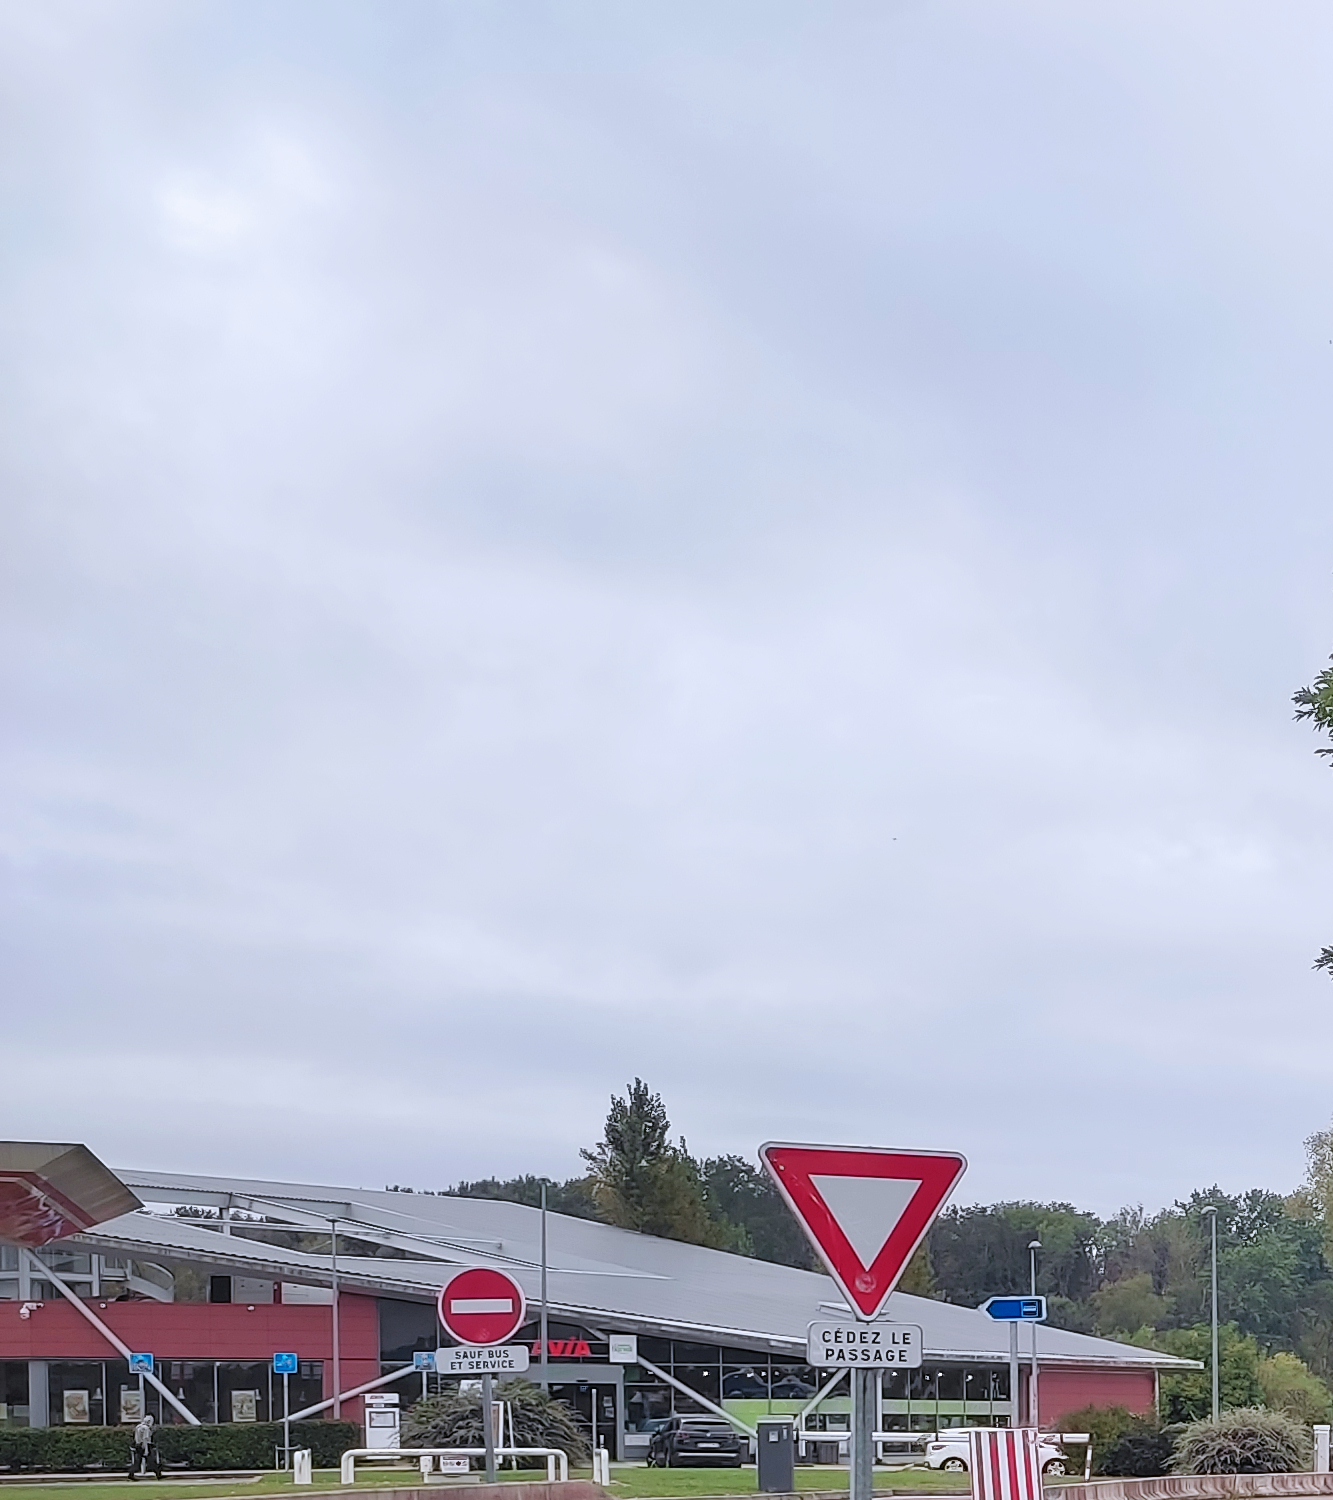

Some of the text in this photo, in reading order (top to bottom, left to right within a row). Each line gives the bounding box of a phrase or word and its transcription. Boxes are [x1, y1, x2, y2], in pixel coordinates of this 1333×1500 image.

[822, 1328, 911, 1345] CÉDEZ LE
[455, 1349, 509, 1360] SAUF BUS
[825, 1348, 907, 1362] PASSAGE
[450, 1360, 515, 1370] ET SERVICE
